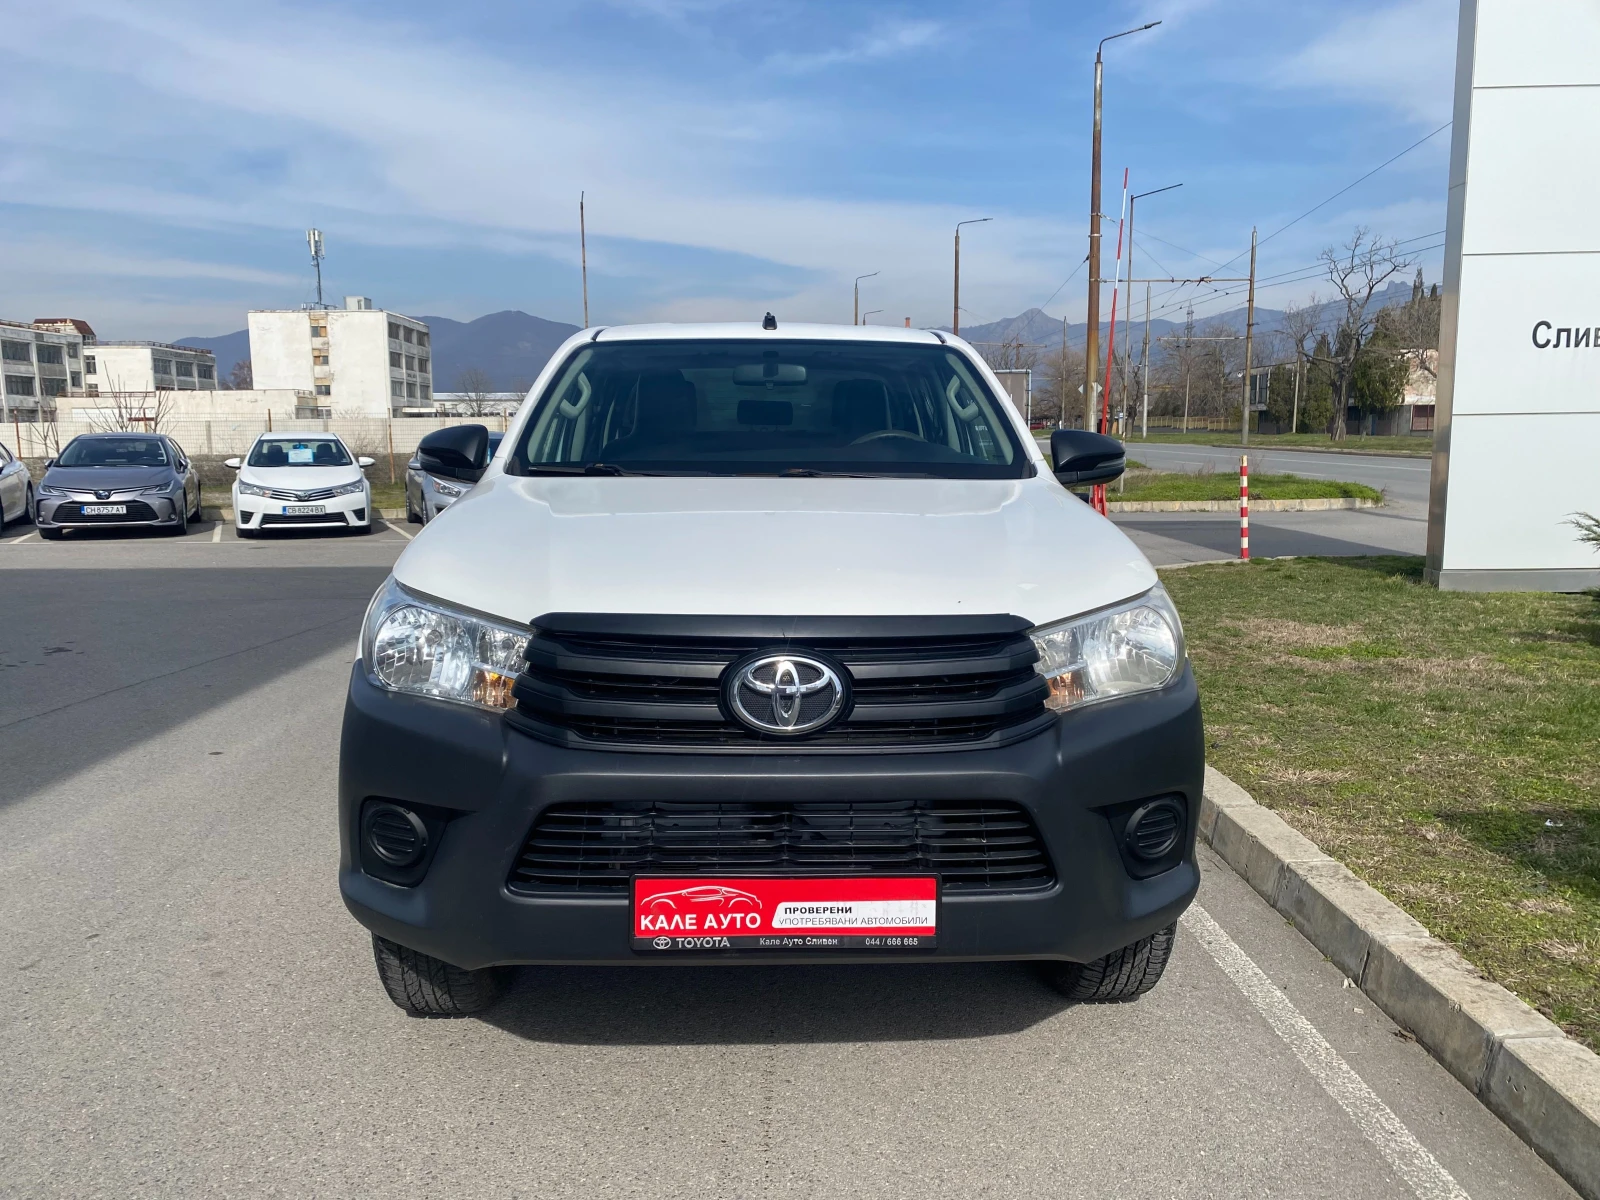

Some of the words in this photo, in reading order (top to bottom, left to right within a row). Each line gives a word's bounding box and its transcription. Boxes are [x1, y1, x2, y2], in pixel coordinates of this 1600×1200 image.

[784, 906, 852, 914] ПРОВЕРЕНИ
[640, 914, 697, 930] КАЛЕ
[703, 912, 761, 930] АУТО
[860, 916, 928, 925] АВТОМОБИЛИ
[676, 937, 730, 948] TOYOTA
[782, 938, 803, 946] Ауто
[865, 938, 880, 946] 044
[887, 938, 902, 946] 666
[903, 937, 918, 946] 665
